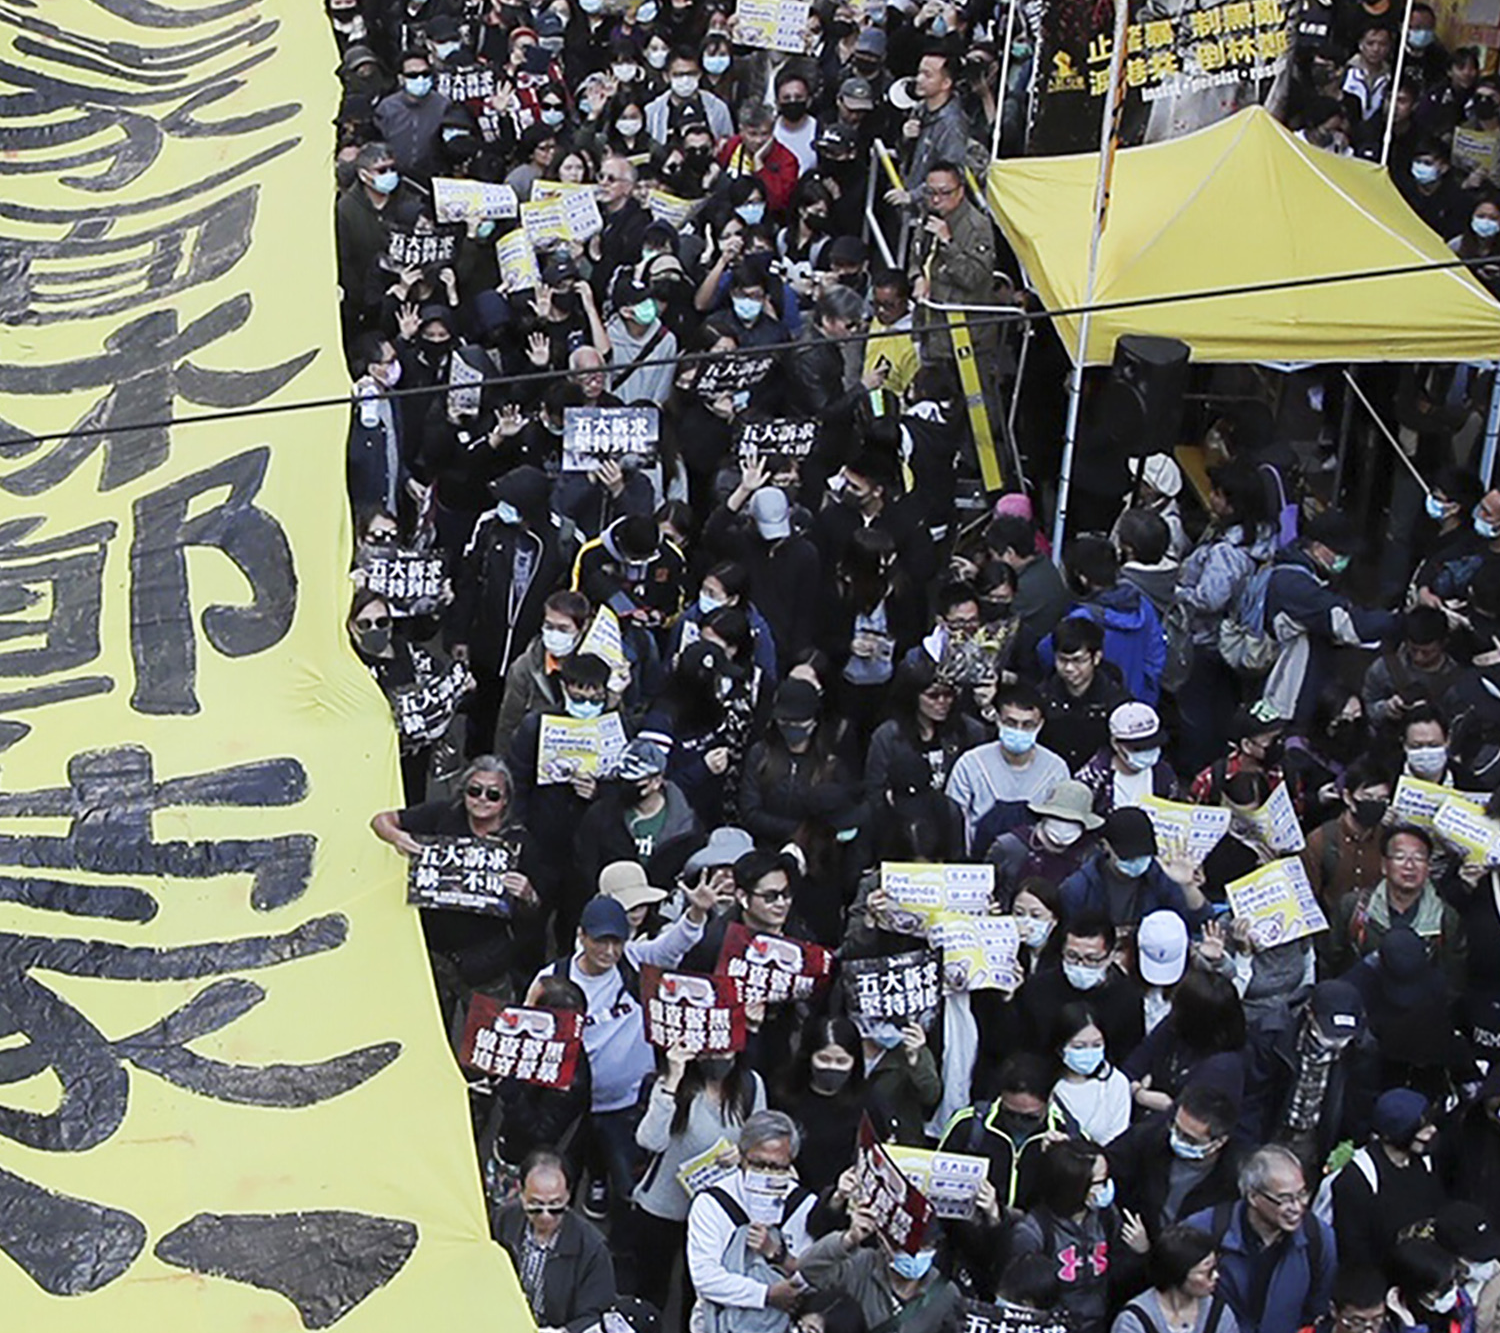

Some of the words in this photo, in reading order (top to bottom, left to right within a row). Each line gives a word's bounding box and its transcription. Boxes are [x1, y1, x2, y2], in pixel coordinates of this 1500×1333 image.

[573, 414, 651, 440] 五大訴求
[420, 844, 510, 870] 五大訴求
[416, 866, 504, 896] 缺一不可
[855, 967, 939, 993] 五大訴求
